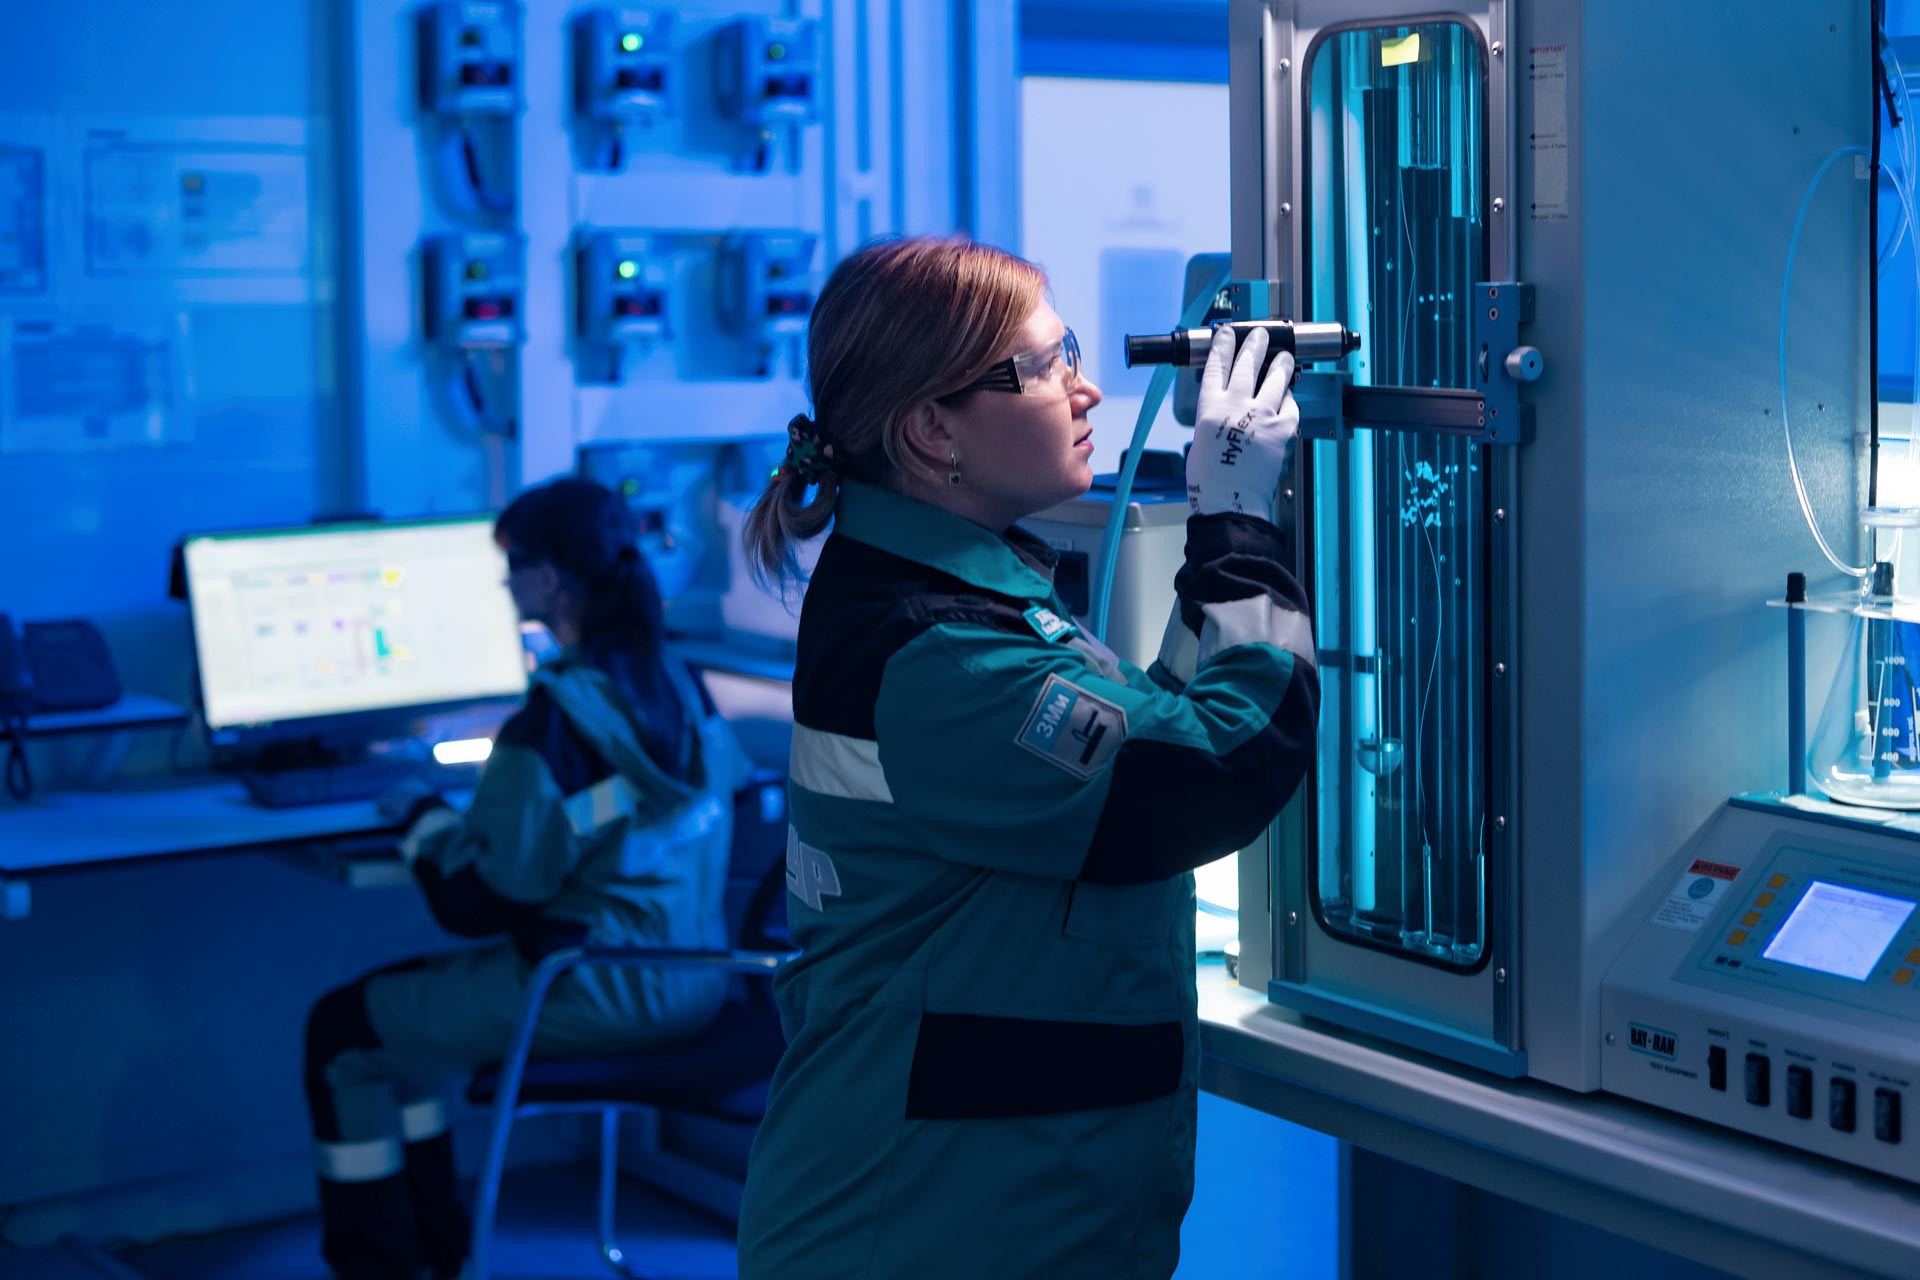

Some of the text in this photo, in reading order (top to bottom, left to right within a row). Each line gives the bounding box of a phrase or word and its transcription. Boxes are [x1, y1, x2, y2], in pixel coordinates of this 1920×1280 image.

[1530, 45, 1568, 54] IMPORTANT
[1220, 411, 1255, 466] HyFlex
[1884, 656, 1905, 666] 1000
[1883, 697, 1901, 707] 800
[1882, 727, 1900, 737] 600
[1881, 752, 1899, 762] 400
